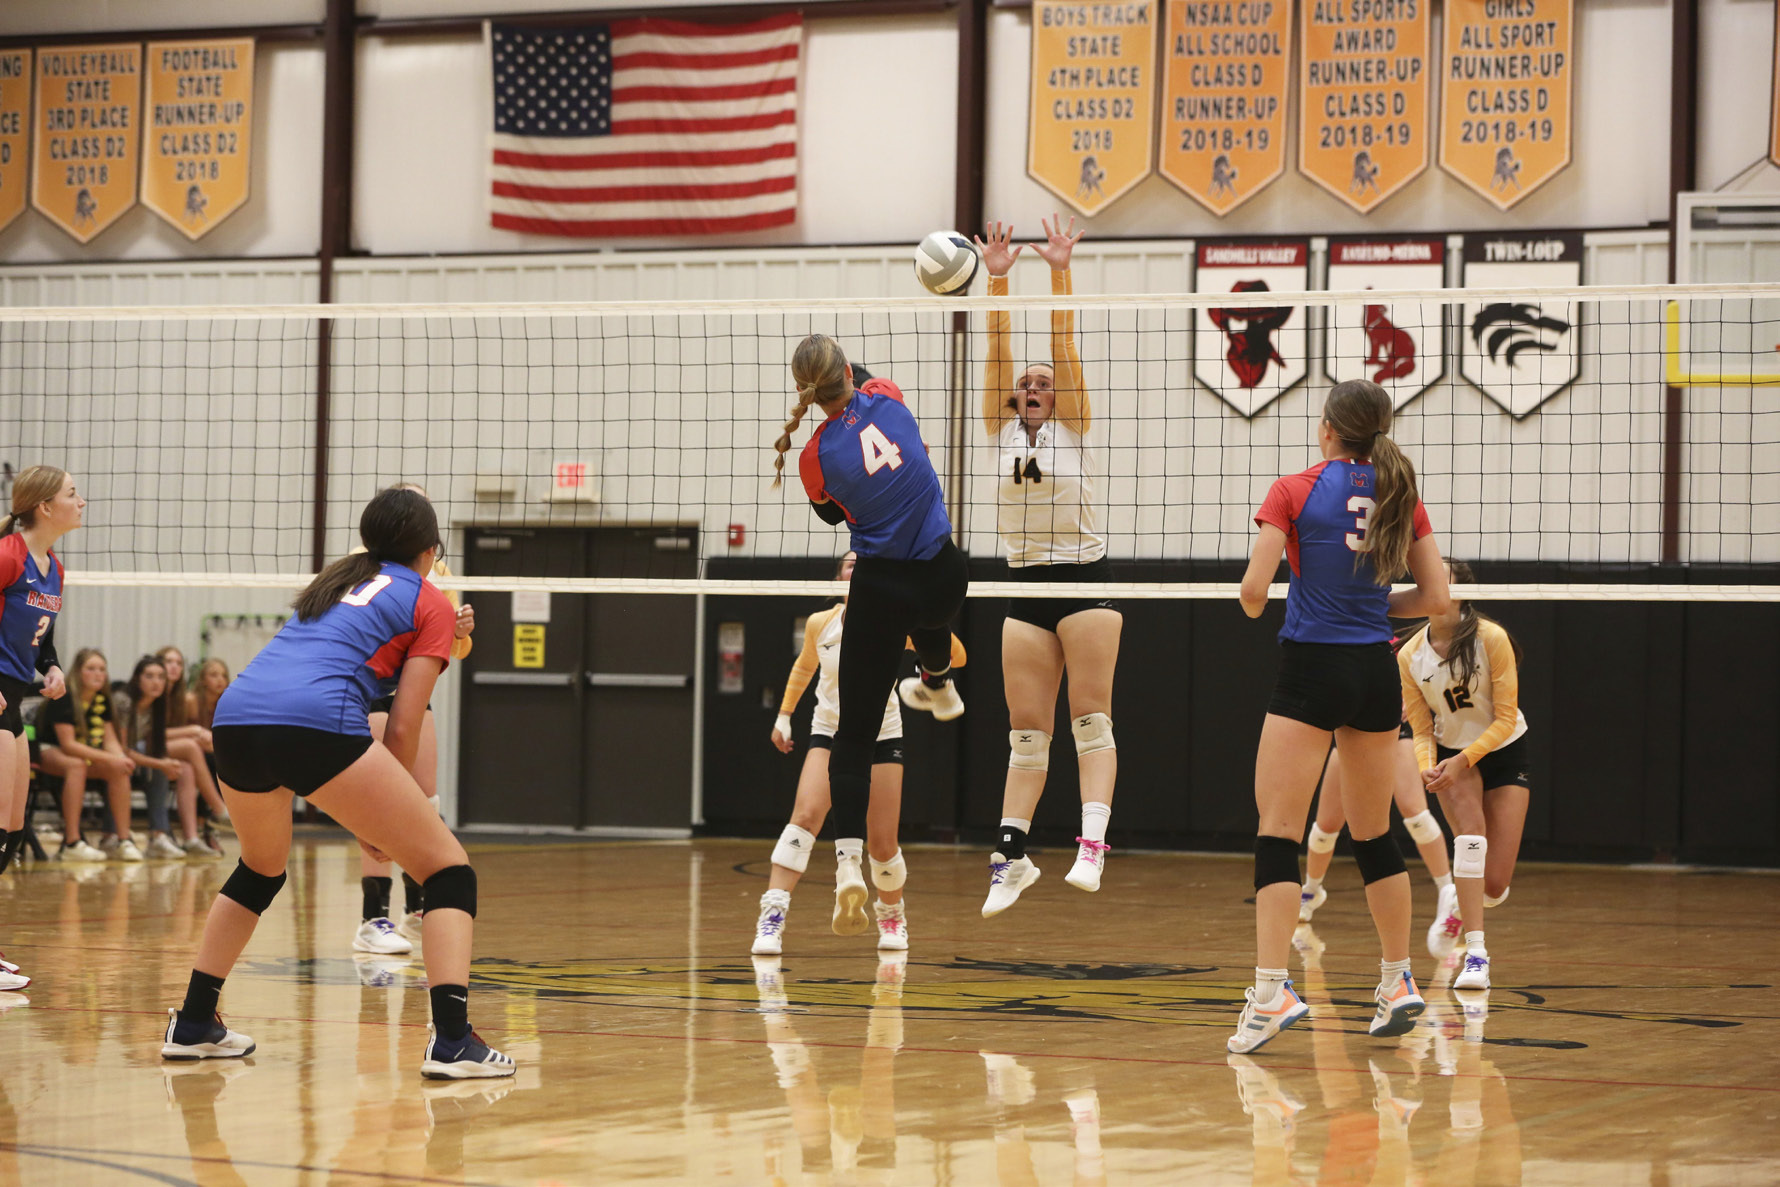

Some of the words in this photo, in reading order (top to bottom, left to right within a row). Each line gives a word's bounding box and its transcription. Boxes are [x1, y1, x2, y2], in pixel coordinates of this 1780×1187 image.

[1042, 6, 1087, 26] BOYS
[1092, 5, 1148, 25] TRACK
[1186, 4, 1233, 26] NSAA
[1237, 3, 1273, 25] CUP
[1314, 1, 1345, 23] ALL
[1351, 0, 1417, 22] SPORTS
[1485, 0, 1535, 18] GIRLS
[1068, 35, 1121, 57] STATE
[1175, 33, 1205, 56] ALL
[1210, 33, 1282, 55] SCHOOL
[1333, 28, 1396, 52] AWARD
[1461, 25, 1494, 49] ALL
[1500, 22, 1556, 48] SPORT
[42, 53, 135, 76] VOLLEYBALL
[162, 49, 237, 71] FOOTBALL
[1309, 58, 1421, 85] RUNNER-UP
[1451, 53, 1565, 80] RUNNER-UP
[177, 76, 222, 97] STATE
[1049, 67, 1080, 87] 4TH
[1086, 66, 1140, 87] PLACE
[1191, 64, 1246, 87] CLASS
[1252, 64, 1263, 86] D
[66, 80, 110, 102] STATE
[1467, 89, 1530, 114] CLASS
[1537, 88, 1548, 111] D
[155, 103, 244, 126] RUNNER-UP
[1053, 98, 1107, 120] CLASS
[1112, 98, 1134, 119] D2
[1175, 97, 1278, 120] RUNNER-UP
[1325, 94, 1386, 118] CLASS
[1394, 93, 1405, 115] D
[48, 108, 75, 130] 3RD
[81, 106, 129, 129] PLACE
[1073, 129, 1113, 150] 2018
[1181, 128, 1269, 150] 2018-19
[1321, 123, 1410, 148] 2018-19
[1462, 119, 1552, 143] 2018-19
[50, 137, 100, 159] CLASS
[106, 136, 125, 157] D2
[160, 134, 211, 155] CLASS
[217, 133, 237, 153] D2
[66, 165, 108, 186] 2018
[176, 161, 219, 181] 2018
[1259, 245, 1298, 264] VALLEY
[1484, 240, 1565, 261] TWIN-LOUP
[858, 421, 904, 478] 4
[557, 463, 586, 488] EXIT
[1014, 457, 1042, 485] 14
[1345, 495, 1377, 553] 3
[31, 614, 51, 647] 2
[1443, 686, 1474, 713] 12
